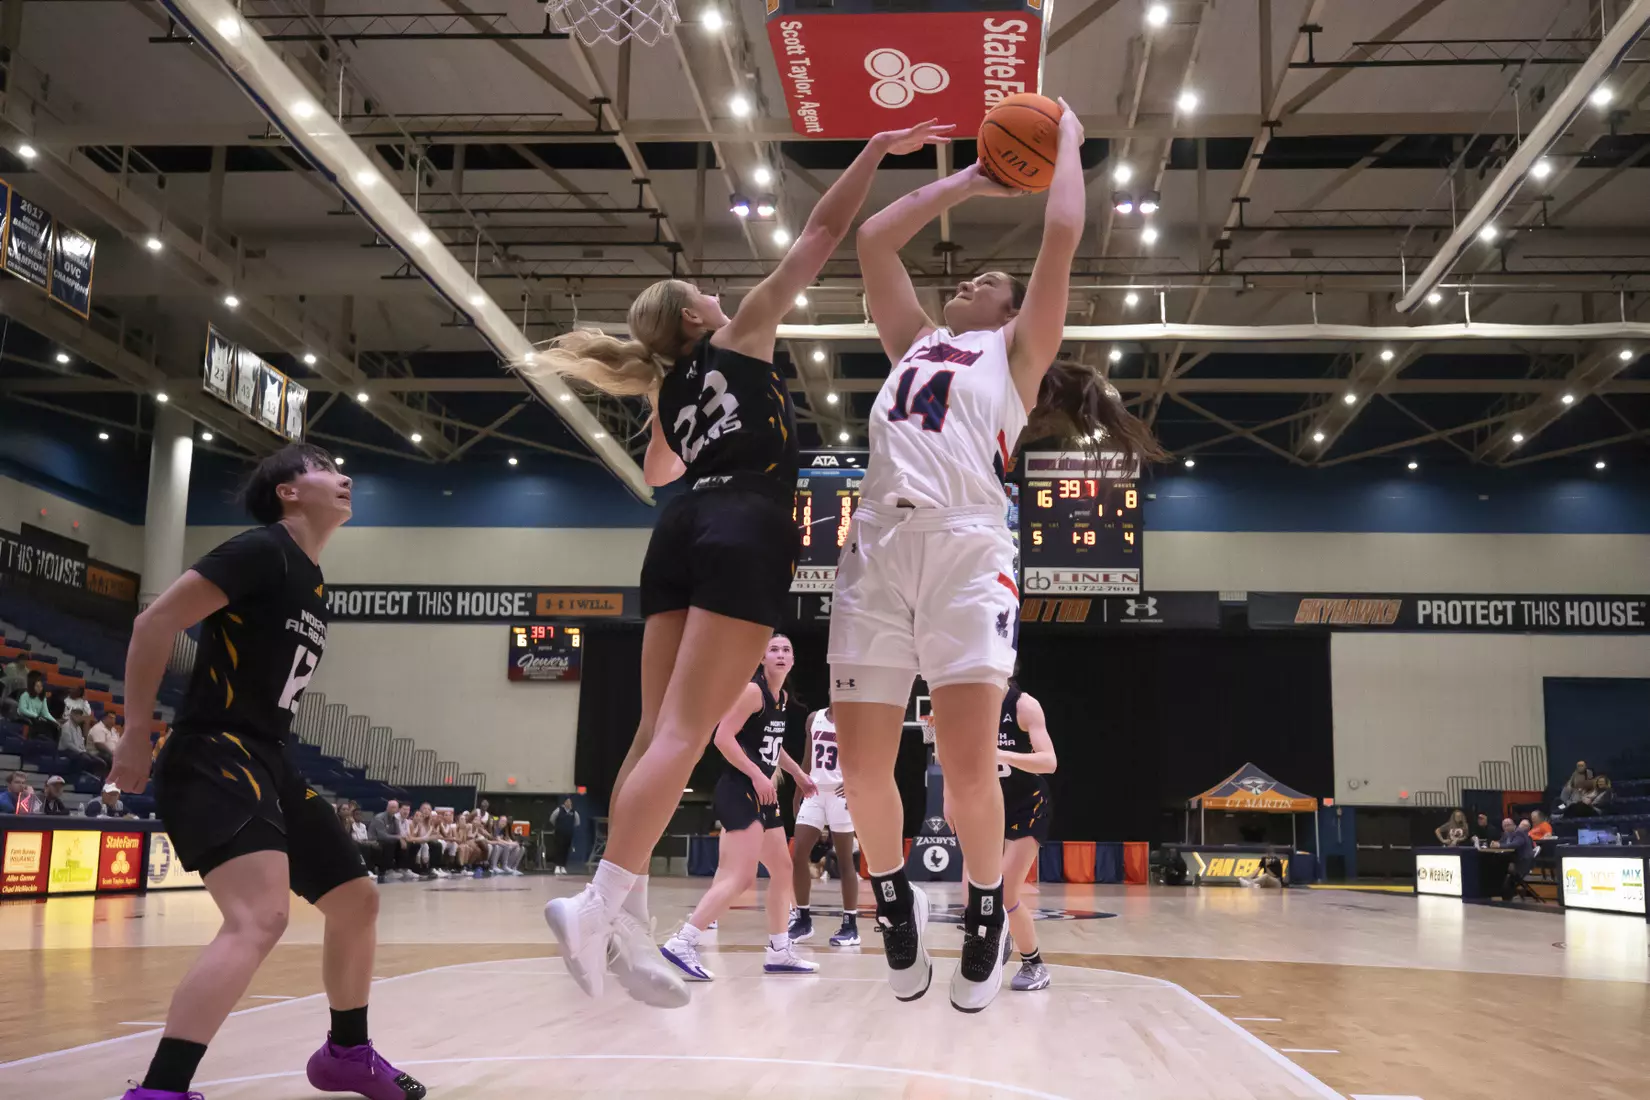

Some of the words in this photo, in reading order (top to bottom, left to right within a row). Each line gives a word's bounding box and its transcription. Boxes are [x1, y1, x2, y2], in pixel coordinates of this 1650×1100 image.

[780, 21, 806, 55] Scott
[983, 18, 1028, 115] StateFa
[787, 57, 815, 98] Taylor,
[797, 101, 824, 133] Agent
[20, 200, 44, 220] 2017
[64, 262, 81, 279] OVC
[54, 270, 89, 297] CHAMPIONS
[888, 366, 955, 433] 14
[674, 370, 740, 463] 23
[811, 455, 839, 466] ATA
[1037, 490, 1052, 508] 16
[1125, 490, 1137, 508] 8
[1032, 530, 1043, 545] 5
[1124, 532, 1134, 545] 4
[796, 570, 838, 579] RAE
[1053, 573, 1138, 583] LINEN
[417, 591, 453, 616] THIS
[1294, 599, 1402, 624] SKYHAWKS
[1417, 600, 1516, 625] PROTECT
[1520, 601, 1560, 626] THIS
[278, 645, 318, 714] 12
[759, 735, 783, 766] 20
[815, 743, 838, 770] 23
[1246, 799, 1294, 808] MARTIN
[916, 836, 956, 847] ZAXBY'S
[1206, 858, 1235, 876] FAN
[1430, 868, 1453, 884] Weakley
[1622, 869, 1642, 880] MIX
